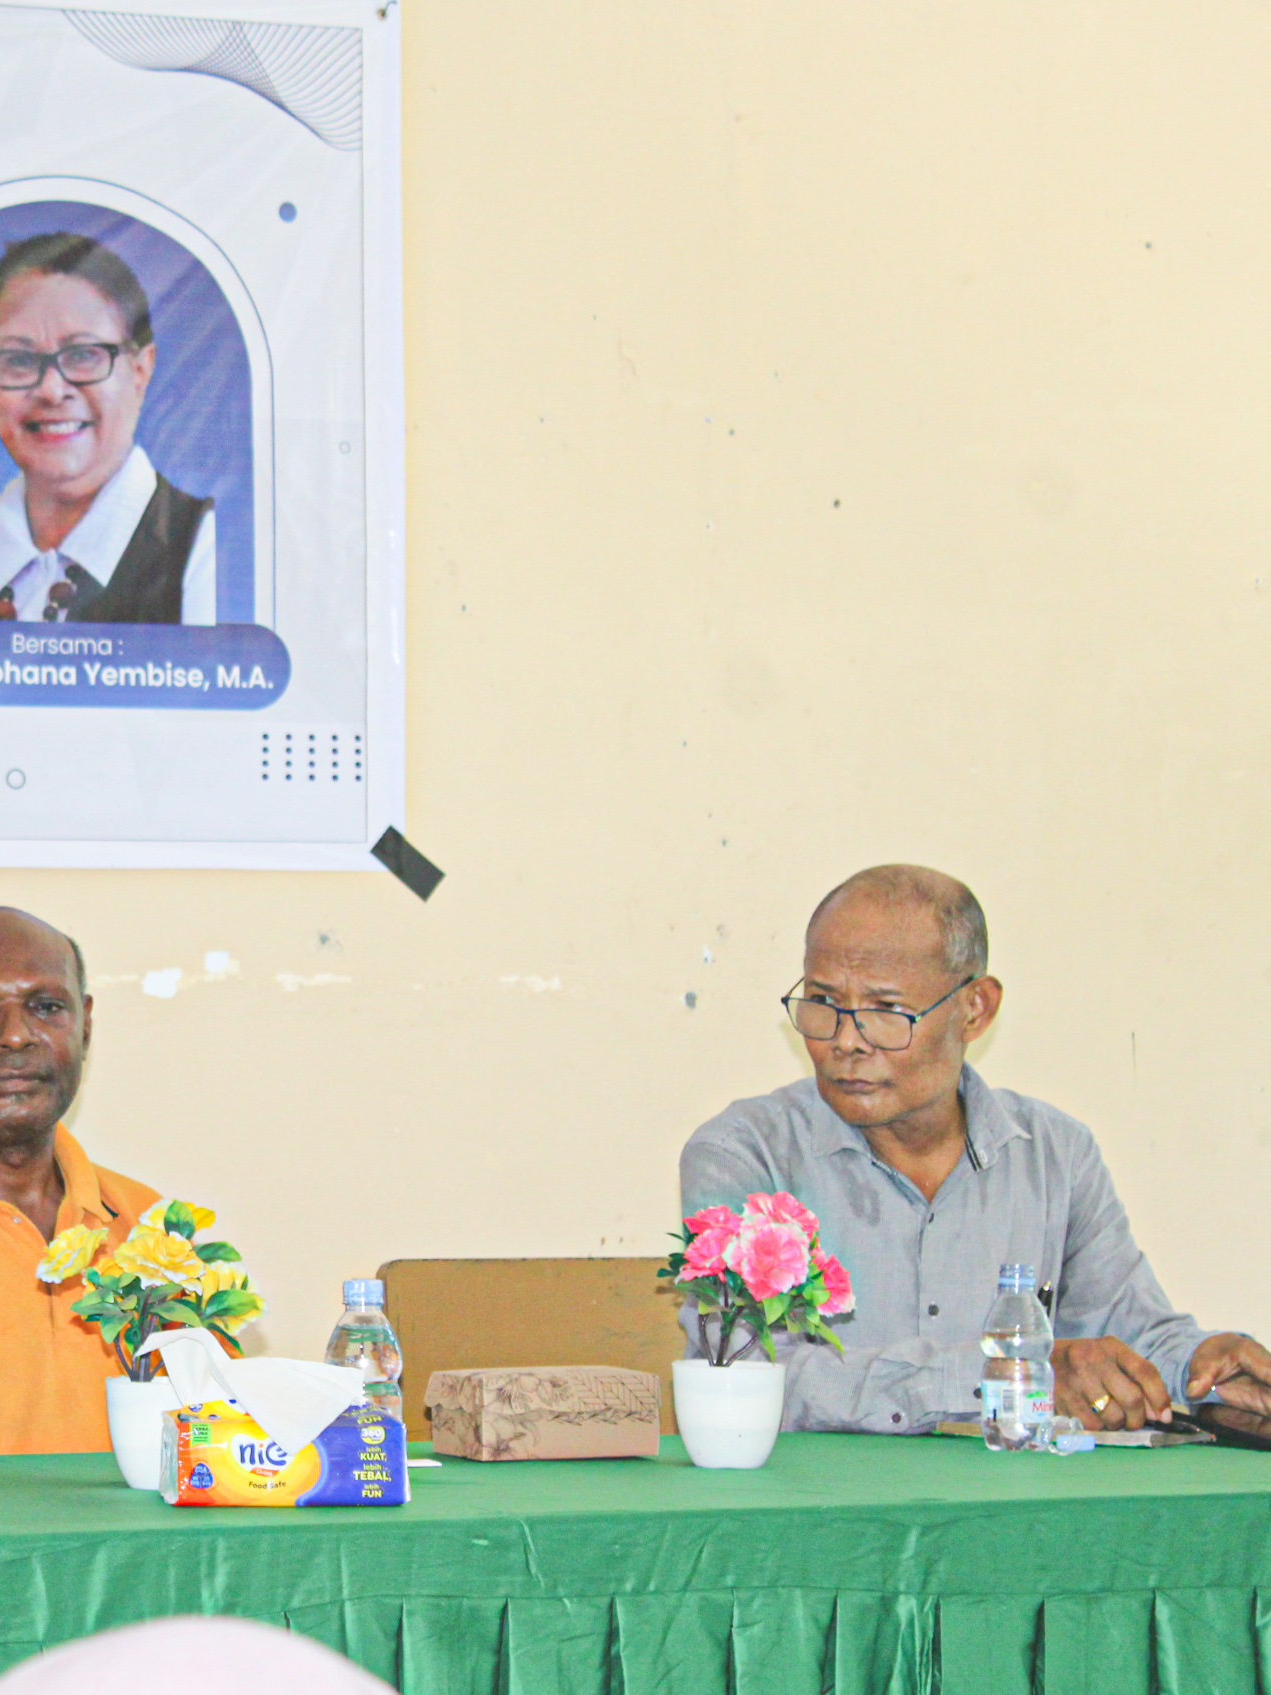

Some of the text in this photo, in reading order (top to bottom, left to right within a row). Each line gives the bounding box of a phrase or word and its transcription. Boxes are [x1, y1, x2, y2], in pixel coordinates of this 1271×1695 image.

[11, 632, 113, 656] Bersama
[83, 661, 210, 692] Yembise,
[216, 664, 274, 689] M.A.
[361, 1427, 382, 1438] 360
[248, 1481, 268, 1490] Food
[362, 1490, 382, 1498] FUN
